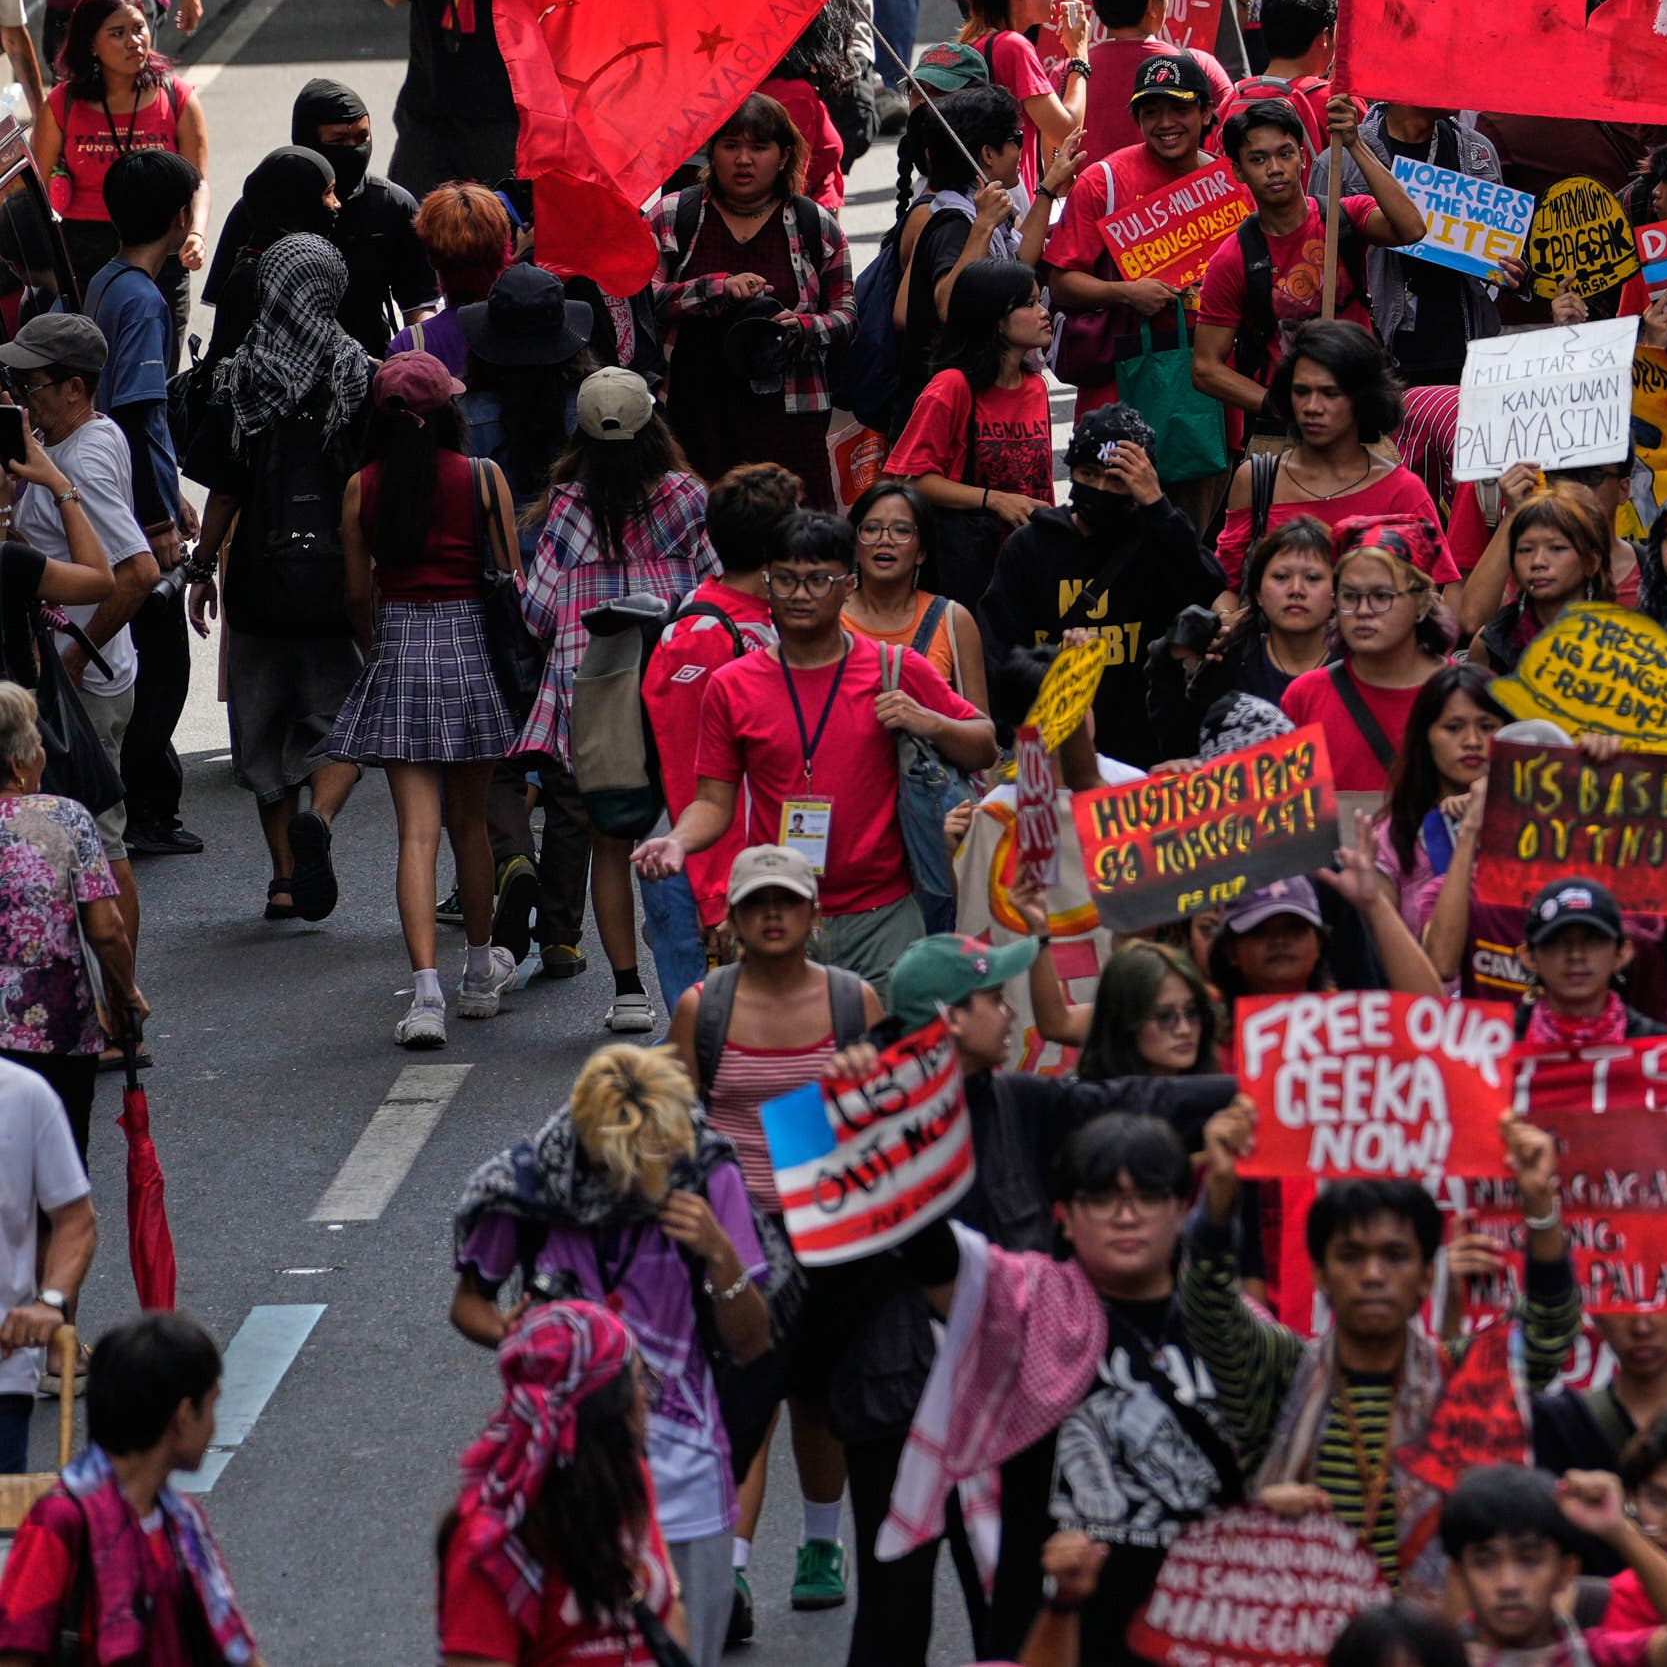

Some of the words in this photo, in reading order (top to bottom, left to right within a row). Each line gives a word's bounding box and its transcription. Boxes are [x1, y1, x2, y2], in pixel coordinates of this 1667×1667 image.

[1105, 200, 1169, 249] PULIS
[1171, 170, 1235, 218] MILITAR
[1394, 156, 1536, 219] WORKERS
[1424, 190, 1463, 216] THE
[1466, 203, 1526, 236] WORLD
[1473, 351, 1576, 388] MILITAR
[1590, 346, 1618, 368] SA
[1501, 373, 1619, 413] KANAYUNAN
[1456, 403, 1623, 472] PALAYASIN!
[1549, 636, 1584, 667] NG
[1242, 991, 1394, 1081] FREE
[1405, 996, 1514, 1089] OUR
